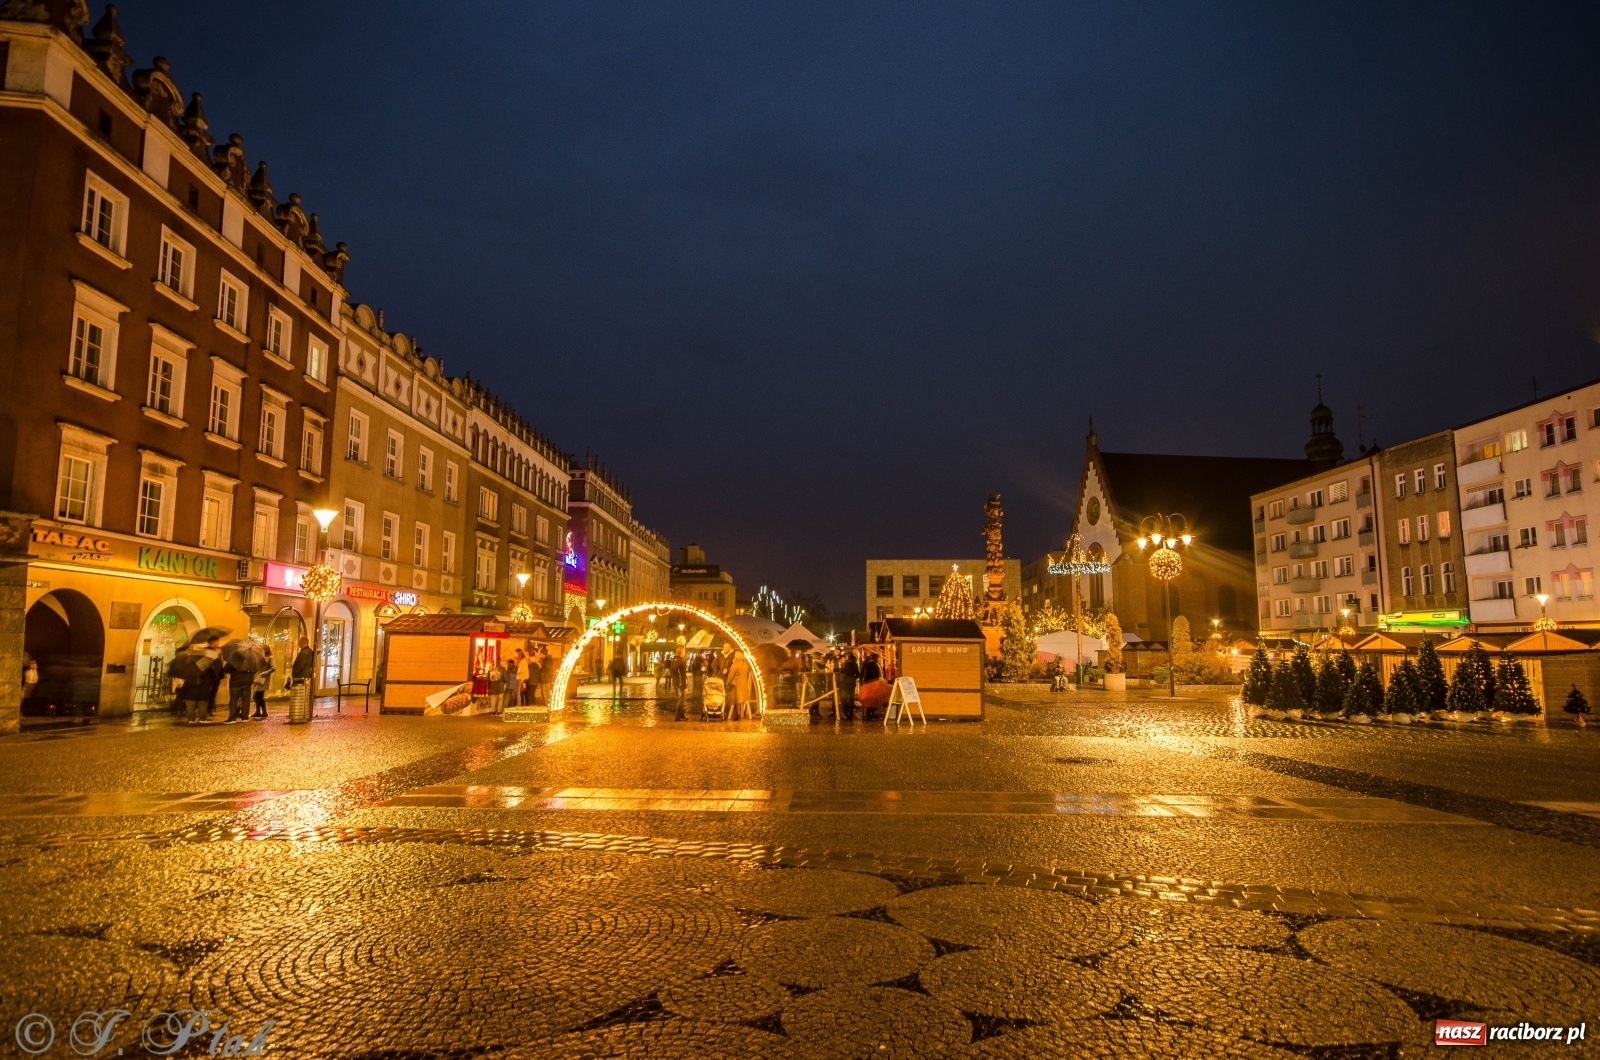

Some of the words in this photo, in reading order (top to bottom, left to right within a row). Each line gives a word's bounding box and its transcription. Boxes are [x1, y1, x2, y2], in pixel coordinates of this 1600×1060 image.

[32, 529, 110, 552] TABAC
[139, 546, 219, 577] KANTOR
[349, 586, 387, 601] RESTAURACJA
[394, 591, 416, 606] SHIRO
[911, 646, 941, 654] GRZANE
[946, 646, 968, 654] WINO
